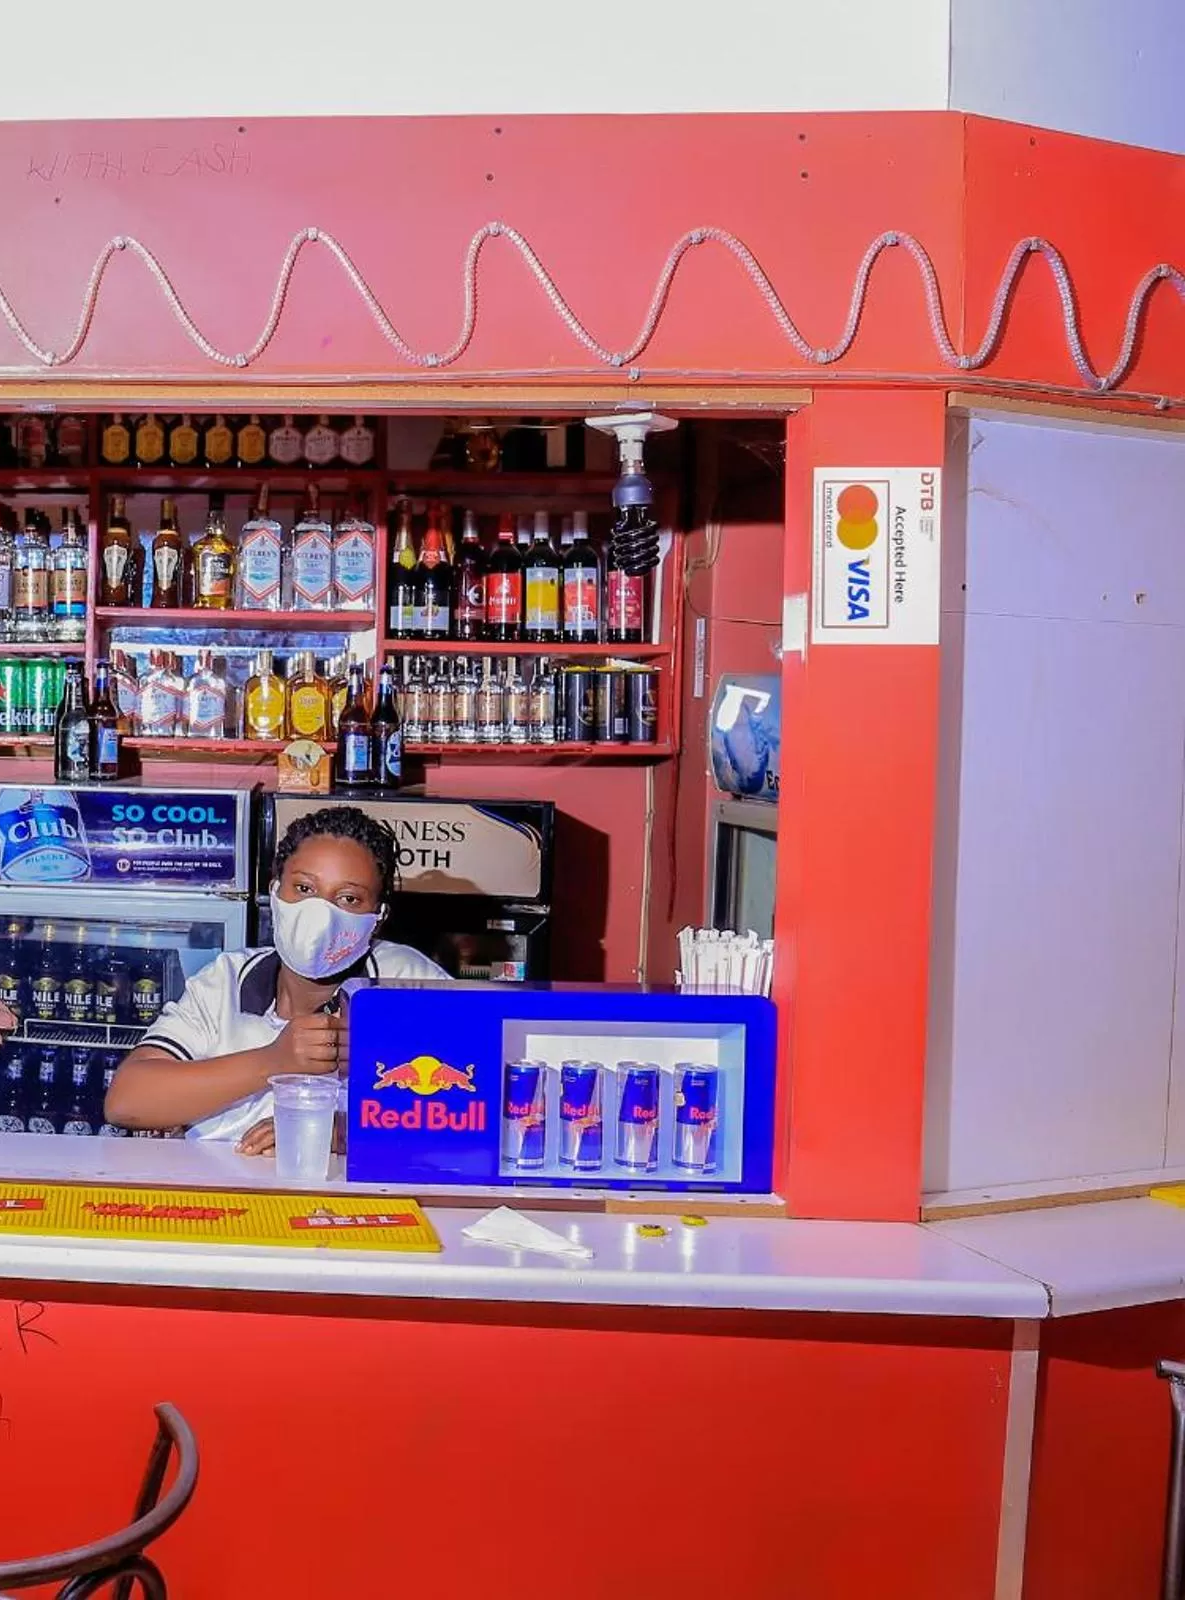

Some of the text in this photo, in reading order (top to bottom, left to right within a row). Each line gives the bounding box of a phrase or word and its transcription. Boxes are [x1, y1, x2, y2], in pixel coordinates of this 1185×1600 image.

[24, 150, 127, 182] WITH
[141, 140, 253, 176] CASH
[920, 472, 935, 511] DTB
[825, 487, 833, 549] mastercard
[891, 506, 907, 604] Accepted Here
[847, 554, 870, 622] VISA
[112, 804, 227, 823] SO COOL.
[8, 813, 76, 844] Club
[112, 827, 150, 846] SO
[397, 848, 451, 868] OTH
[33, 991, 60, 1003] NILE
[65, 993, 92, 1005] NILE
[133, 992, 160, 1004] NILE
[361, 1099, 485, 1131] Red Bull
[307, 1215, 401, 1226] BELL
